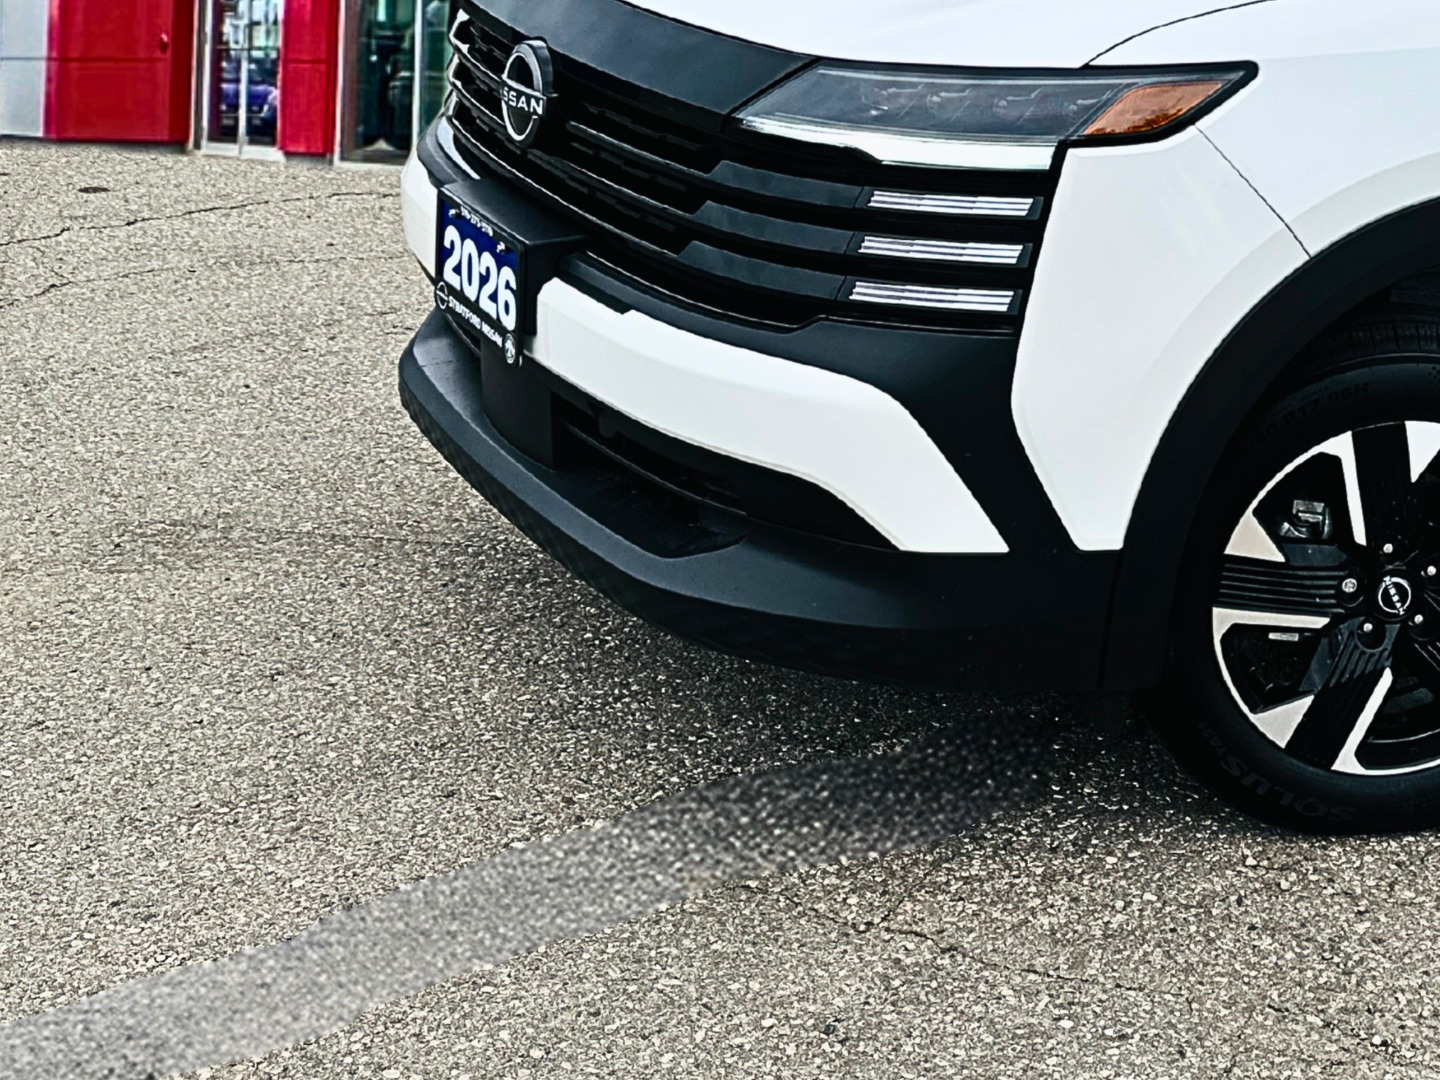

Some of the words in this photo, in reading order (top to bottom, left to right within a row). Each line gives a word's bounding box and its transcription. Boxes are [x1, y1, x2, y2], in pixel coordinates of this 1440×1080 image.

[442, 223, 518, 332] 2026
[1382, 573, 1406, 616] NISSAN
[1219, 746, 1358, 823] SOLUS
